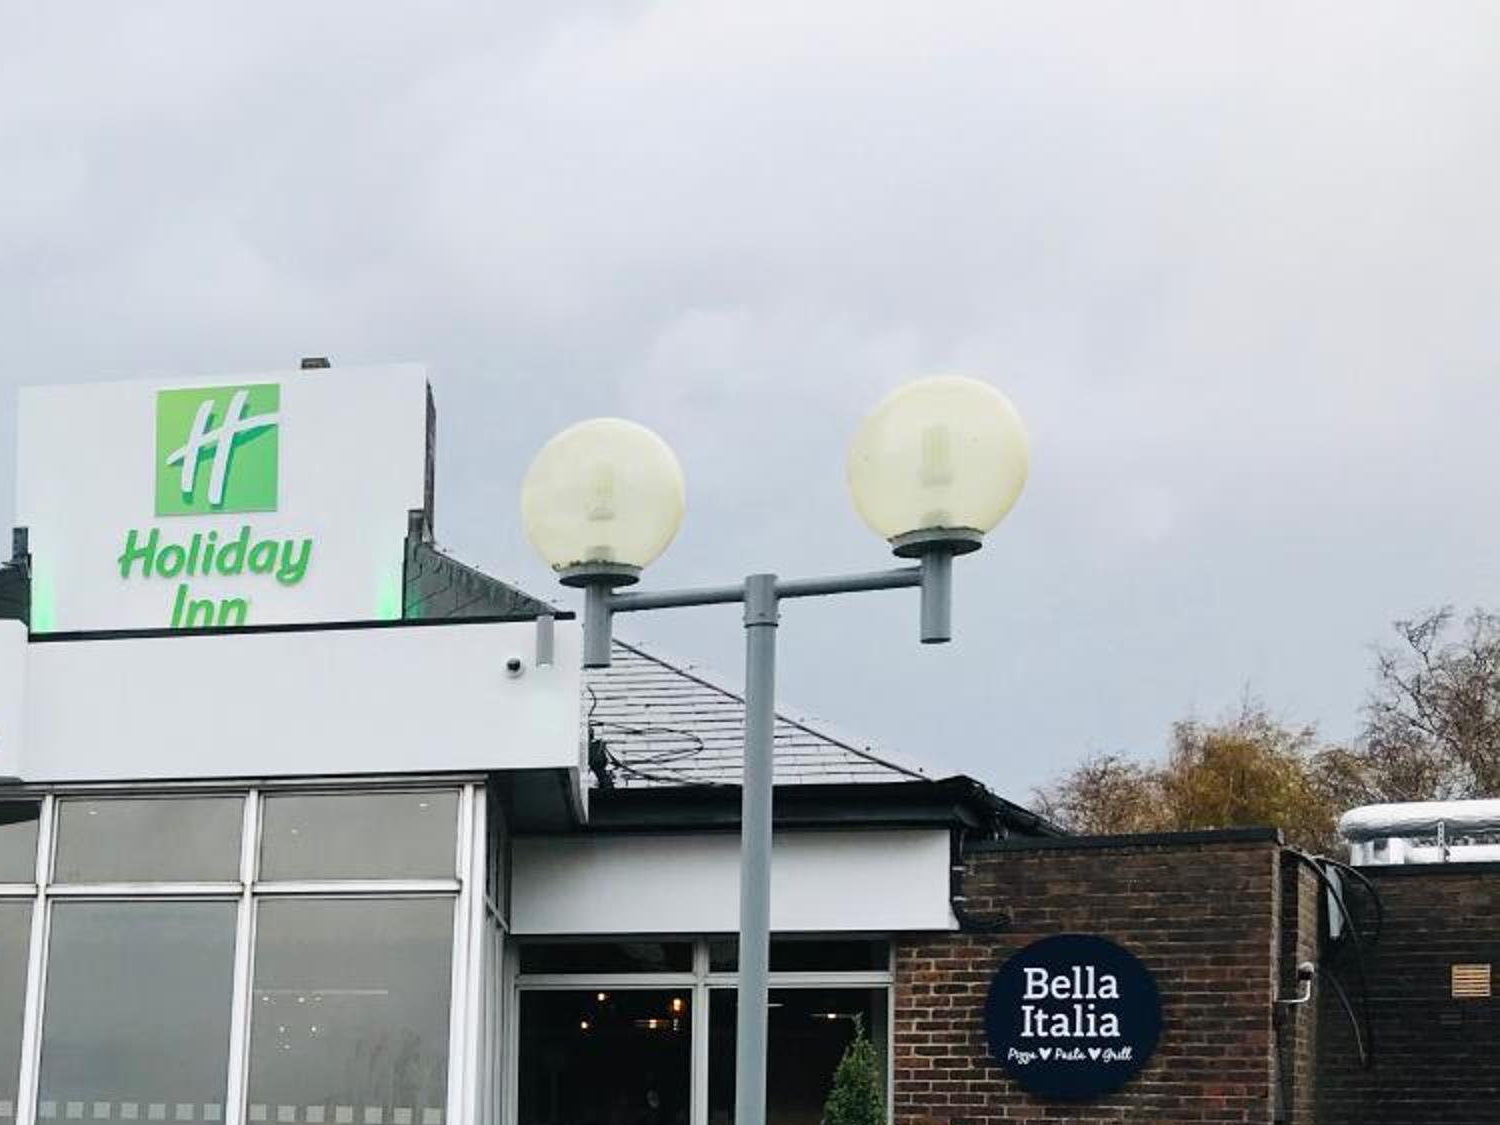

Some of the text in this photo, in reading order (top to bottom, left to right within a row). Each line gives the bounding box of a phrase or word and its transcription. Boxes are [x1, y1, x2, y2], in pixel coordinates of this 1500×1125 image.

[117, 525, 313, 586] Holiday
[169, 583, 249, 628] Inn
[1022, 965, 1120, 999] Bella
[1020, 1003, 1121, 1037] Italia
[1007, 1045, 1133, 1065] Pizza Pasta Grill
